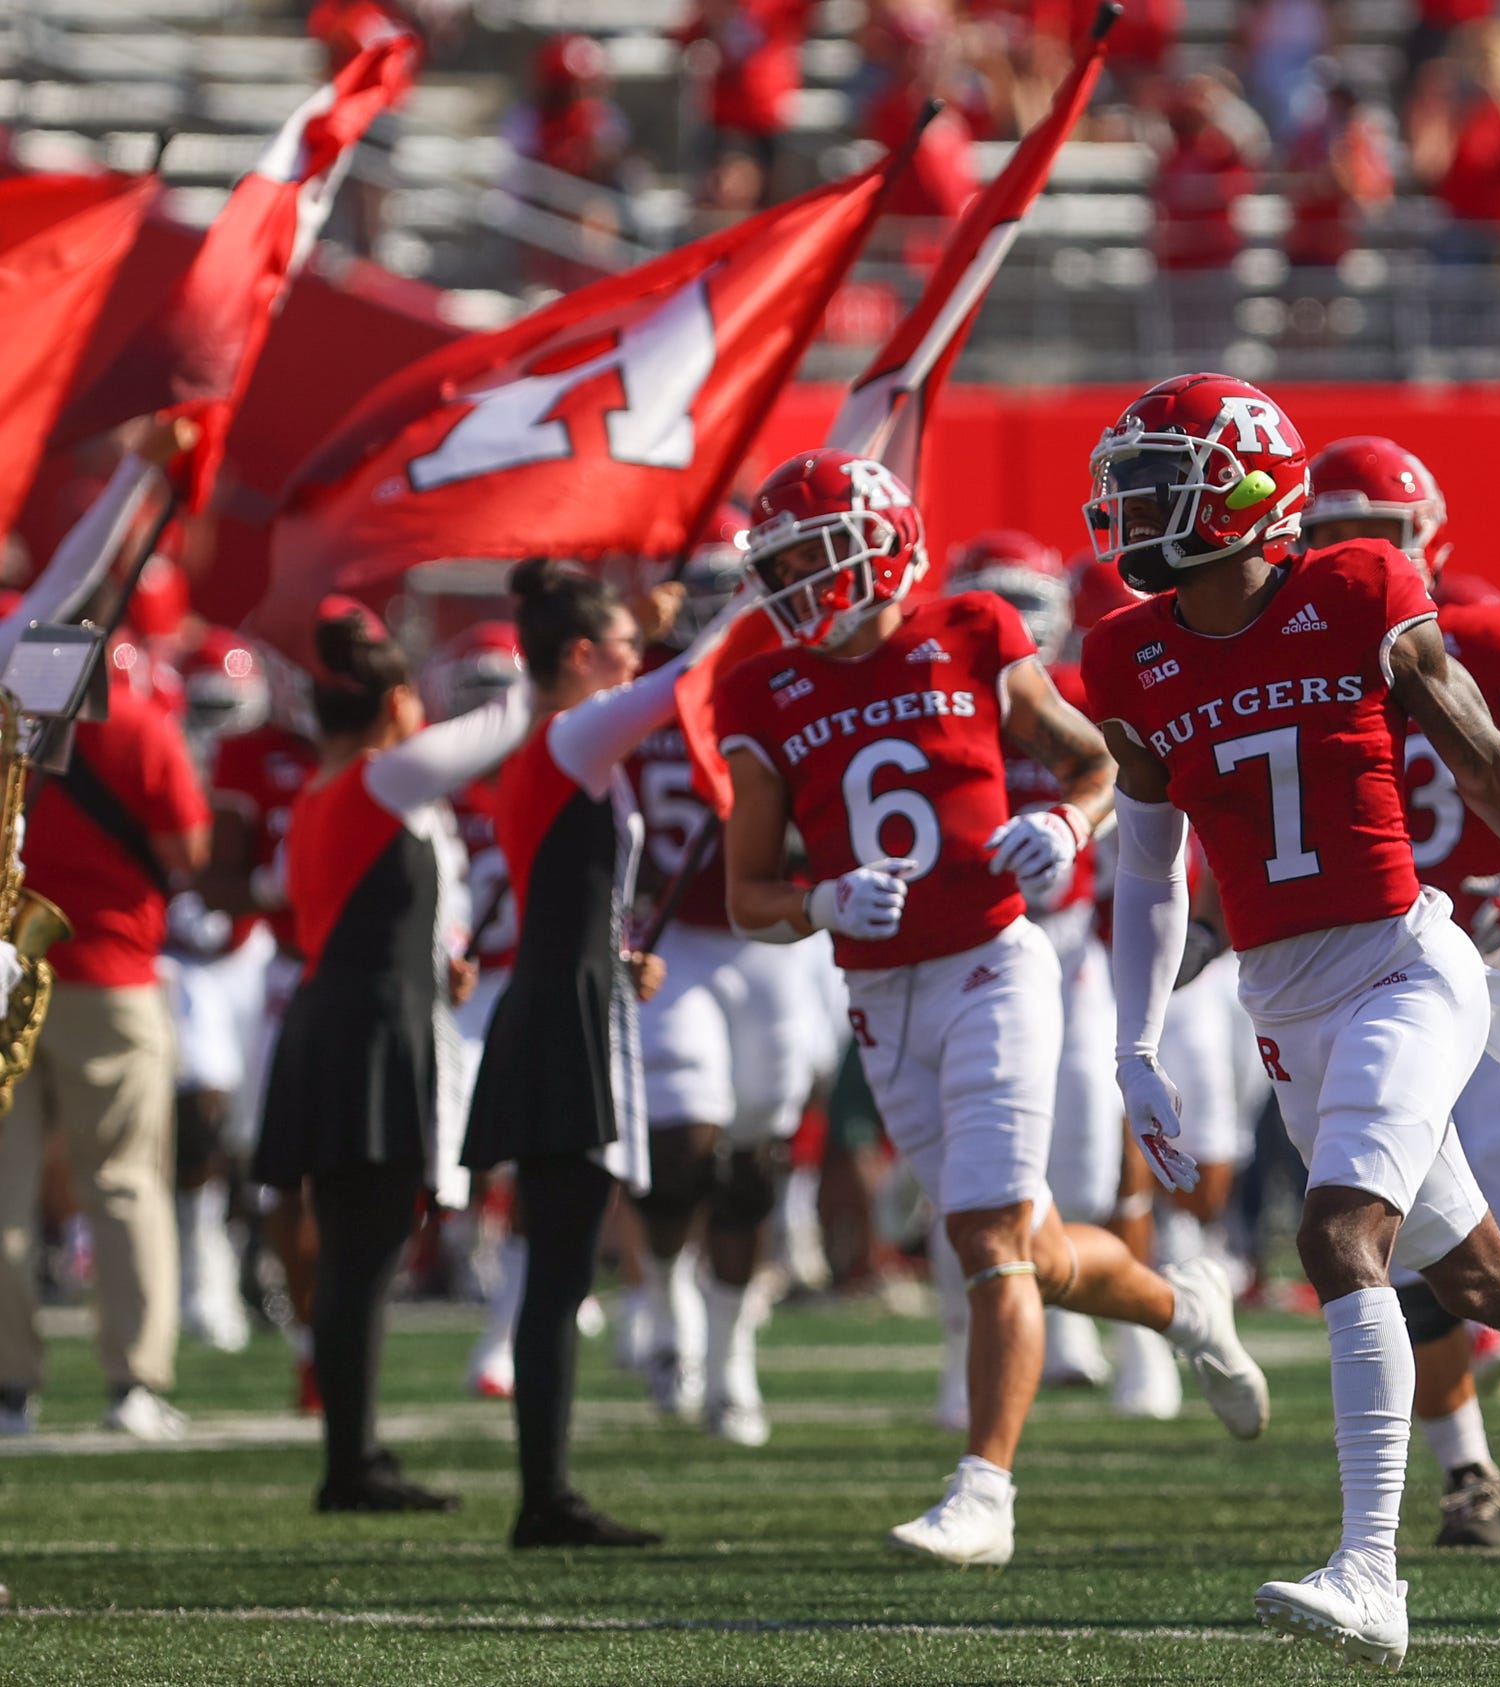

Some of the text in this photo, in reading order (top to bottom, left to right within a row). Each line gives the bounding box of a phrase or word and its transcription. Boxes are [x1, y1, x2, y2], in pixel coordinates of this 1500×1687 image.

[1221, 396, 1294, 458] R
[840, 459, 912, 510] R
[1136, 643, 1163, 663] REM
[782, 690, 976, 765] RUTGERS
[1149, 675, 1365, 759] RUTGERS
[842, 737, 942, 883] 6
[1213, 724, 1321, 884] 7
[1257, 1036, 1292, 1082] R
